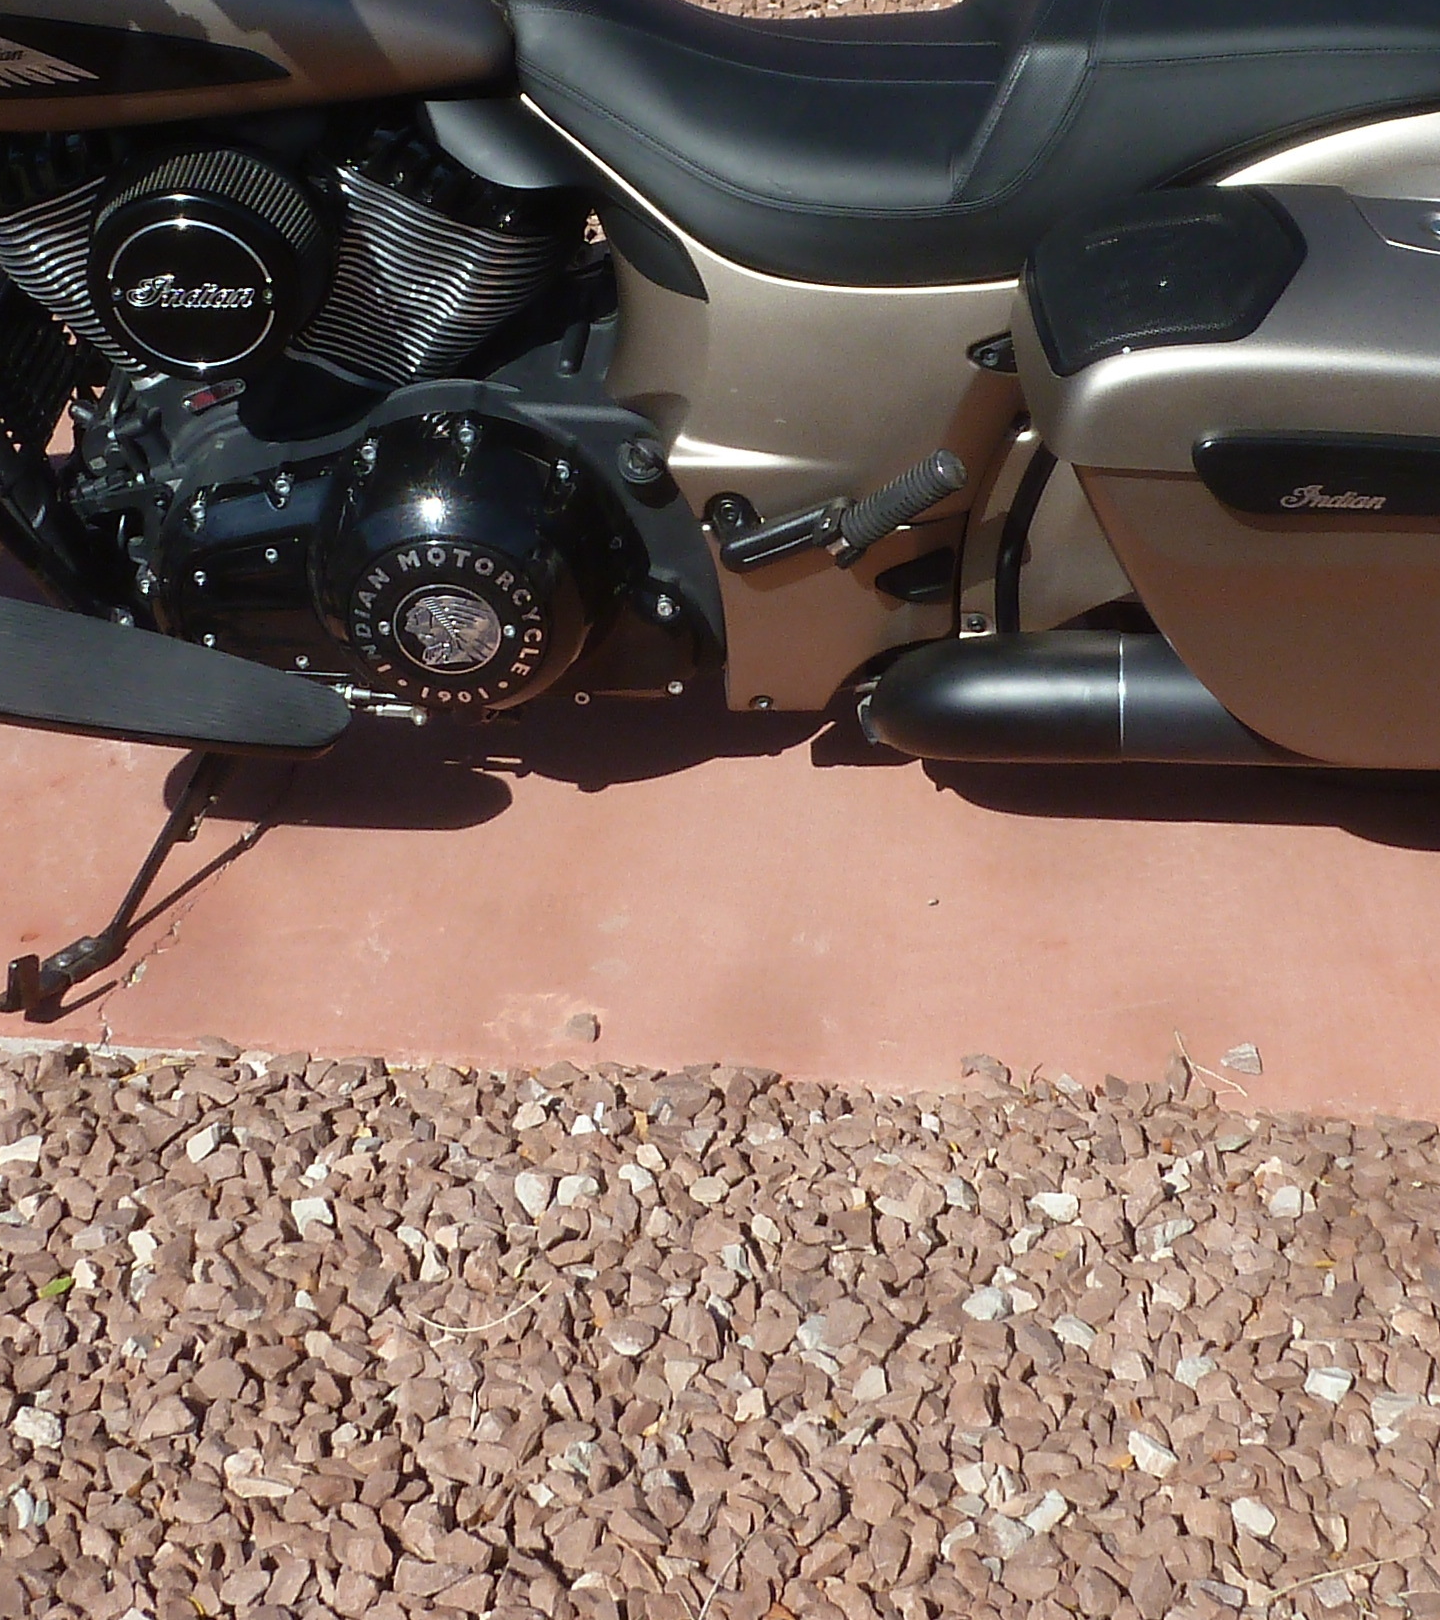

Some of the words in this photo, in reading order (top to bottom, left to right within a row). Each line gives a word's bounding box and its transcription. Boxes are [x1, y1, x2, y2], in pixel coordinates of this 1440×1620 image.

[126, 274, 255, 308] Indian
[1280, 484, 1387, 511] Indian
[353, 567, 392, 674] INDIAN
[396, 546, 543, 677] MOTORCYCLE
[420, 686, 490, 704] 1901
